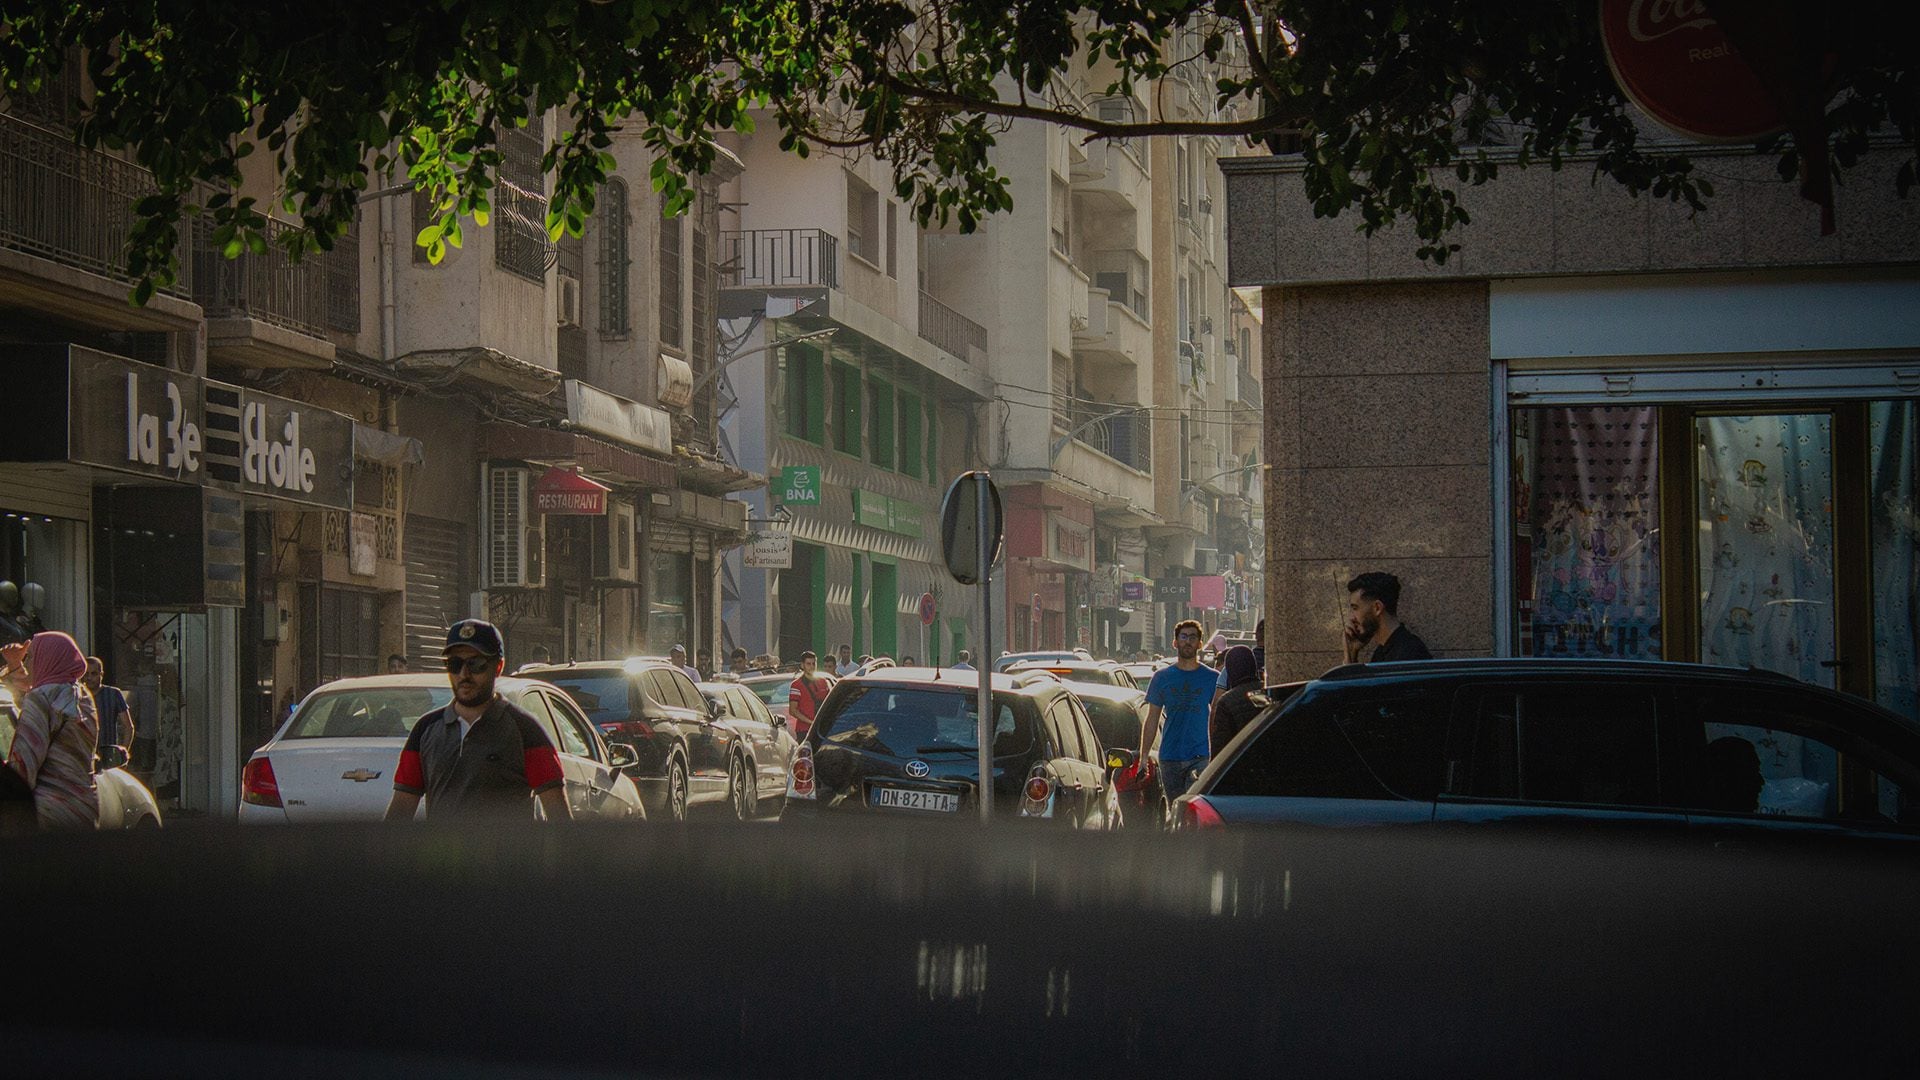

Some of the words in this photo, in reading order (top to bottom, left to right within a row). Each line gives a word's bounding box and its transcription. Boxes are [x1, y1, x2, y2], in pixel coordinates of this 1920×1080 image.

[1688, 40, 1730, 63] Real
[128, 372, 160, 465] la
[537, 493, 600, 510] RESTAURANT
[786, 488, 816, 501] BNA
[1161, 585, 1186, 594] BCR
